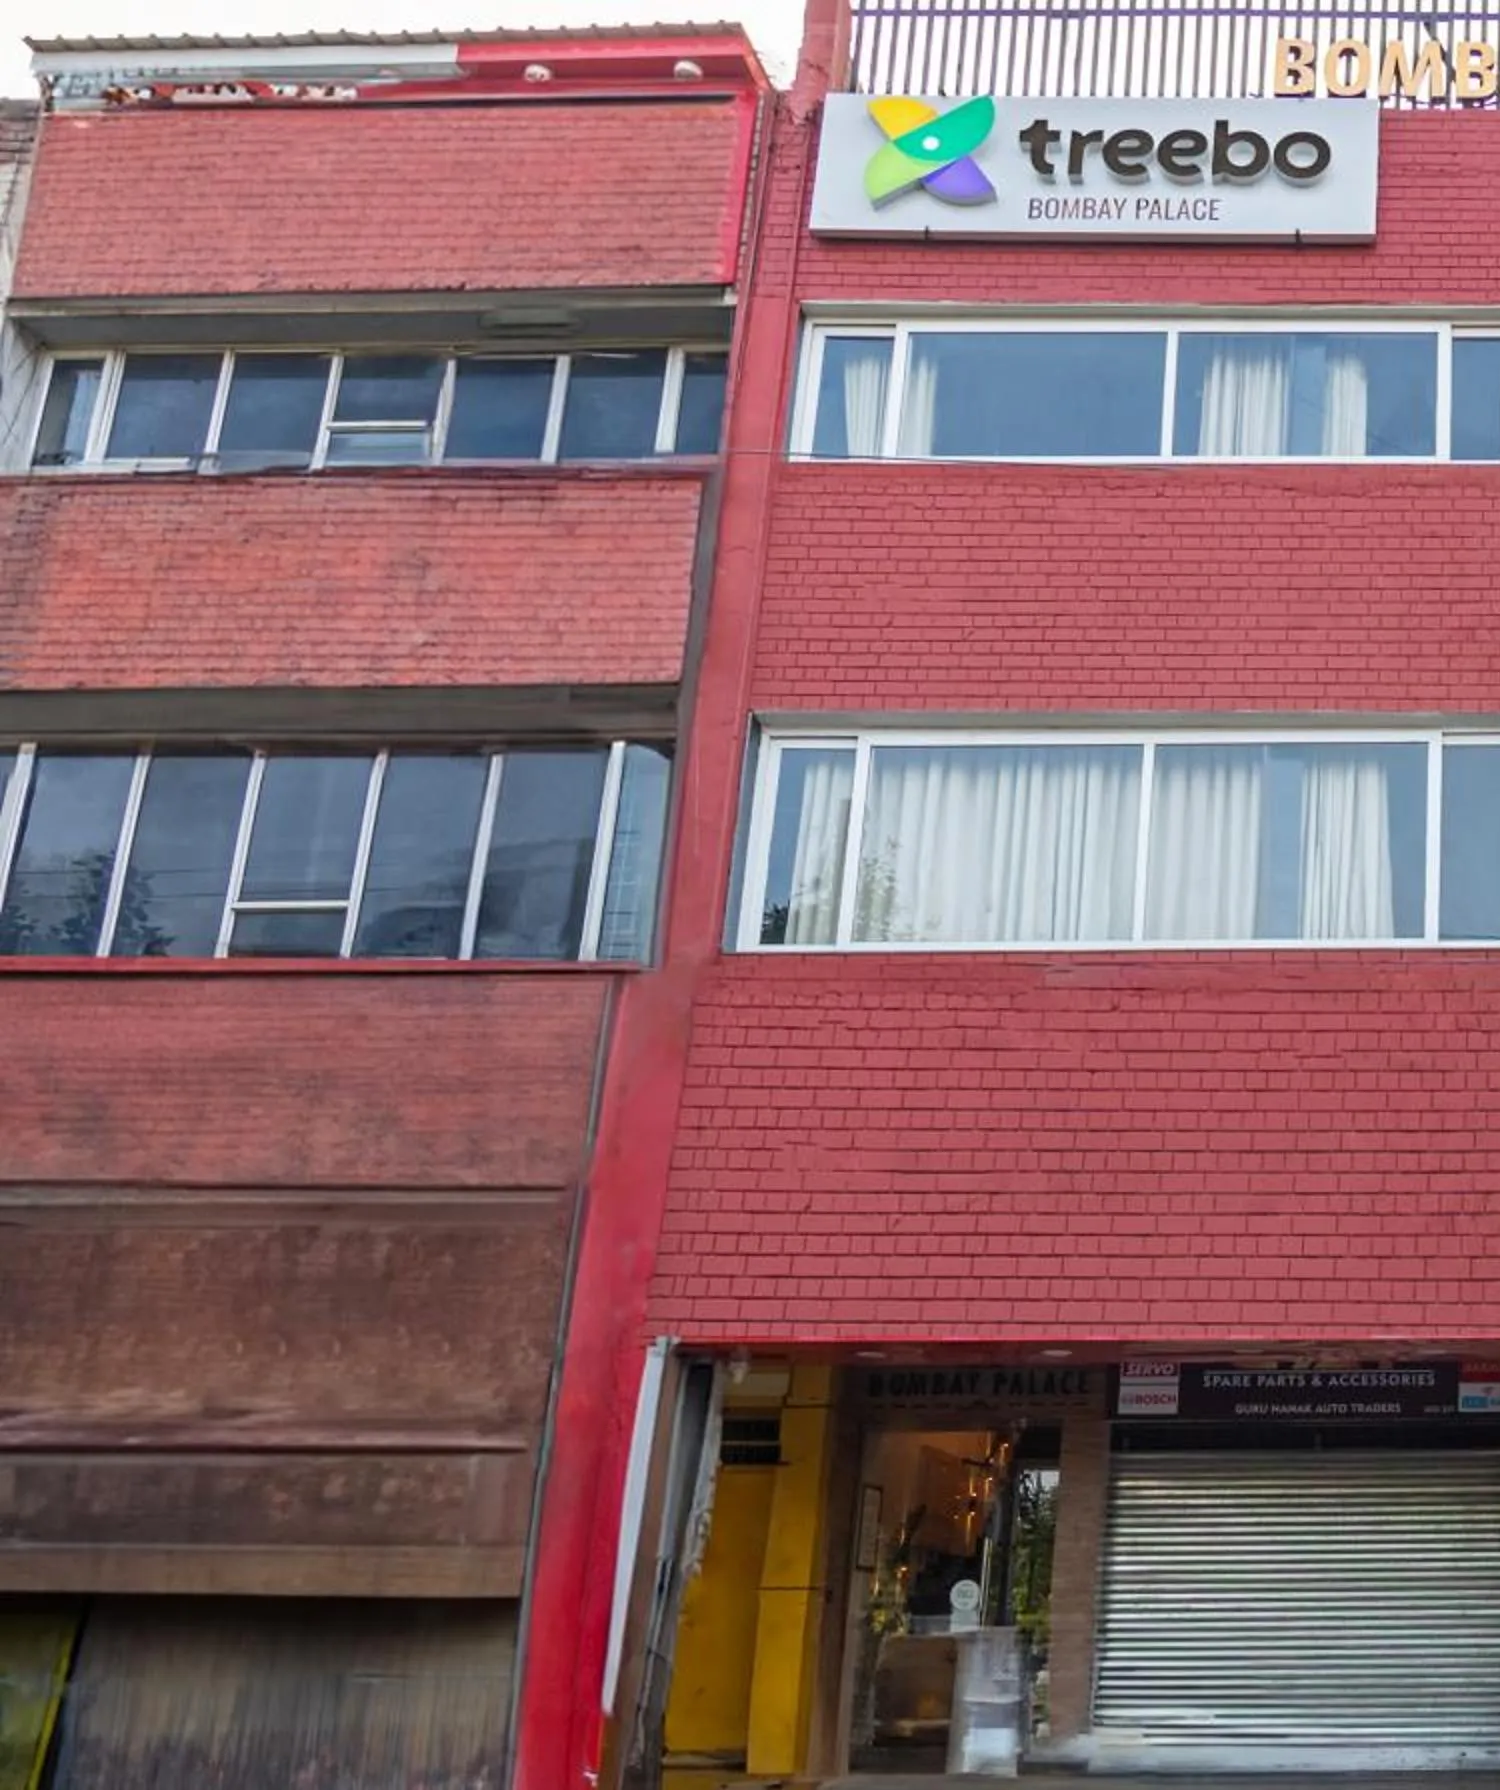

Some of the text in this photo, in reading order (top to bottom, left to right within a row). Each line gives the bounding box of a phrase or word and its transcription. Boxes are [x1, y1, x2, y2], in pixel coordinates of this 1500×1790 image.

[1018, 119, 1332, 184] treebo
[1027, 198, 1224, 221] BOMBAY PALACE
[867, 1369, 1090, 1397] BOMBAY PALACE
[1202, 1374, 1251, 1388] SPARE
[1256, 1374, 1306, 1387] PARTS
[1328, 1373, 1436, 1387] ACCESSORIES
[1234, 1403, 1269, 1414] GURU
[1315, 1403, 1348, 1414] AUTO
[1350, 1402, 1402, 1414] TRADERS
